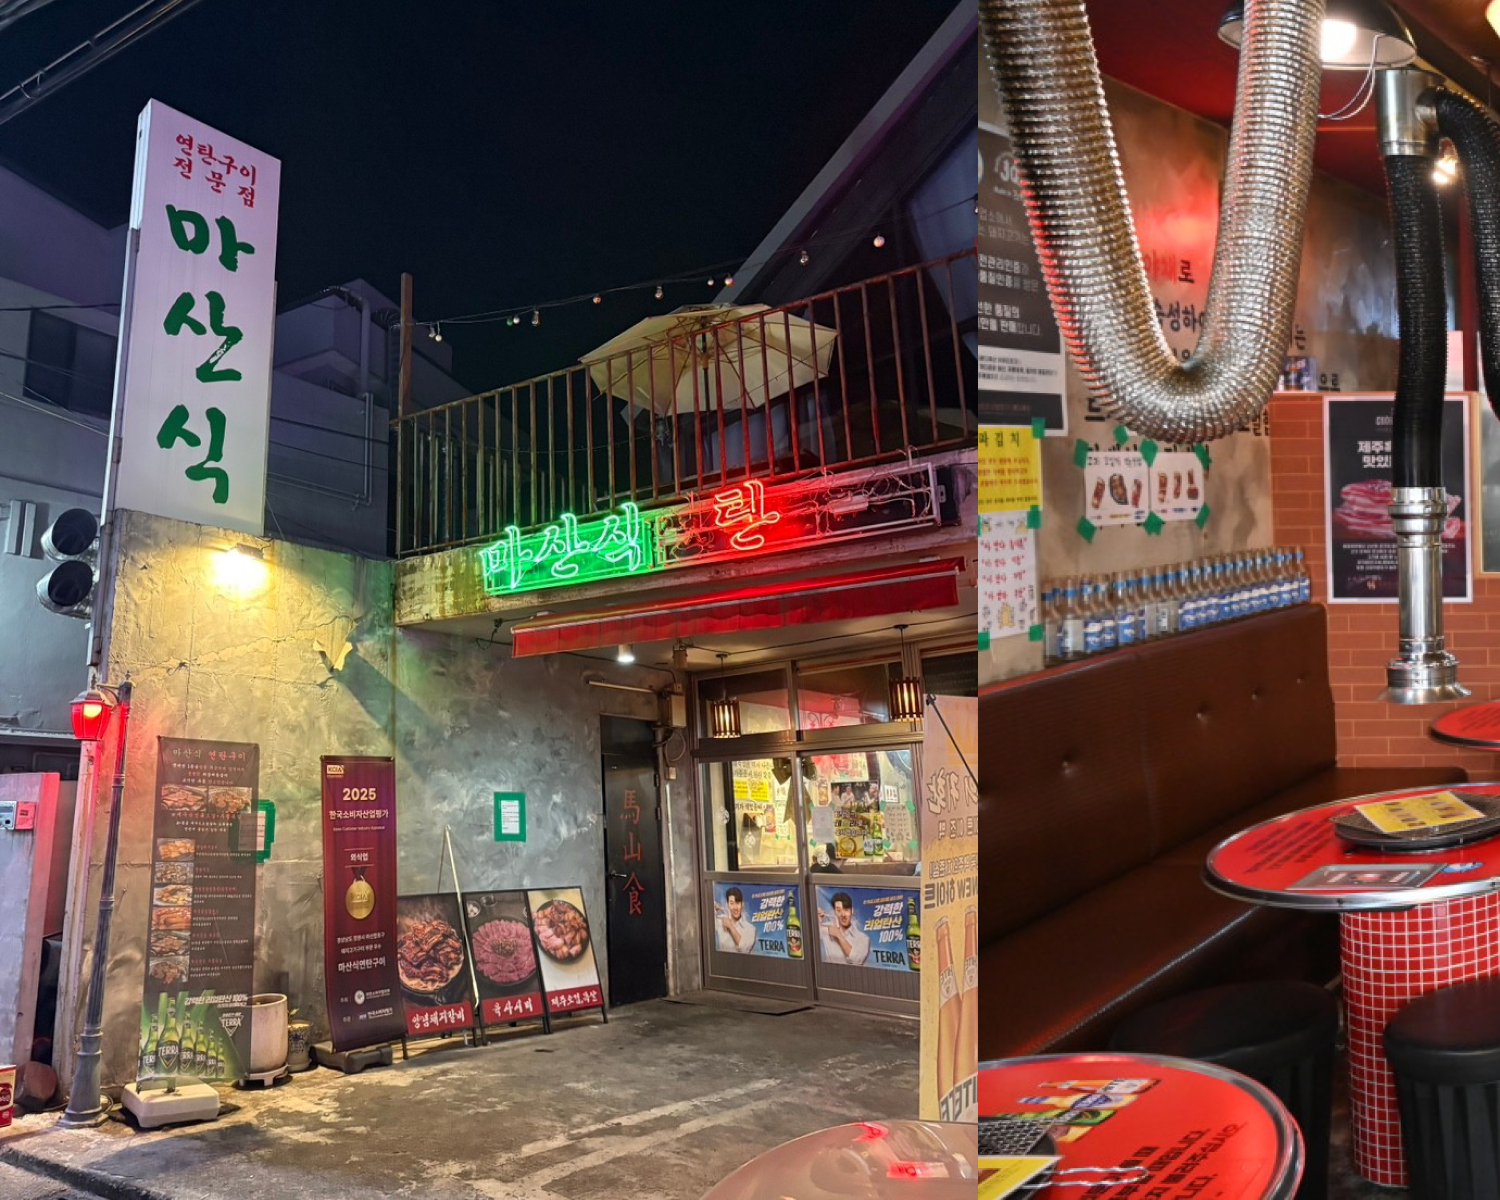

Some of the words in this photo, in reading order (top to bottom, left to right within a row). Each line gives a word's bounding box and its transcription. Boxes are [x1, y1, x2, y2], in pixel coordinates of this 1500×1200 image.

[175, 134, 256, 186] 연탄구이
[156, 204, 255, 505] 마산식
[1362, 455, 1392, 469] 맛있
[481, 502, 642, 590] 마산식
[342, 787, 377, 801] 2025
[329, 809, 389, 820] 한국소비자산업평가
[620, 789, 648, 915] 馬山食
[873, 902, 904, 917] 강력한
[763, 922, 784, 933] 100%
[878, 930, 903, 944] 100%
[758, 939, 786, 954] TERRA
[338, 956, 386, 973] 마산식연탄구이
[873, 949, 906, 966] TERRA
[221, 1018, 242, 1028] TERRA
[411, 1006, 465, 1029] 양념돼지갈비
[158, 1045, 179, 1056] TERRA
